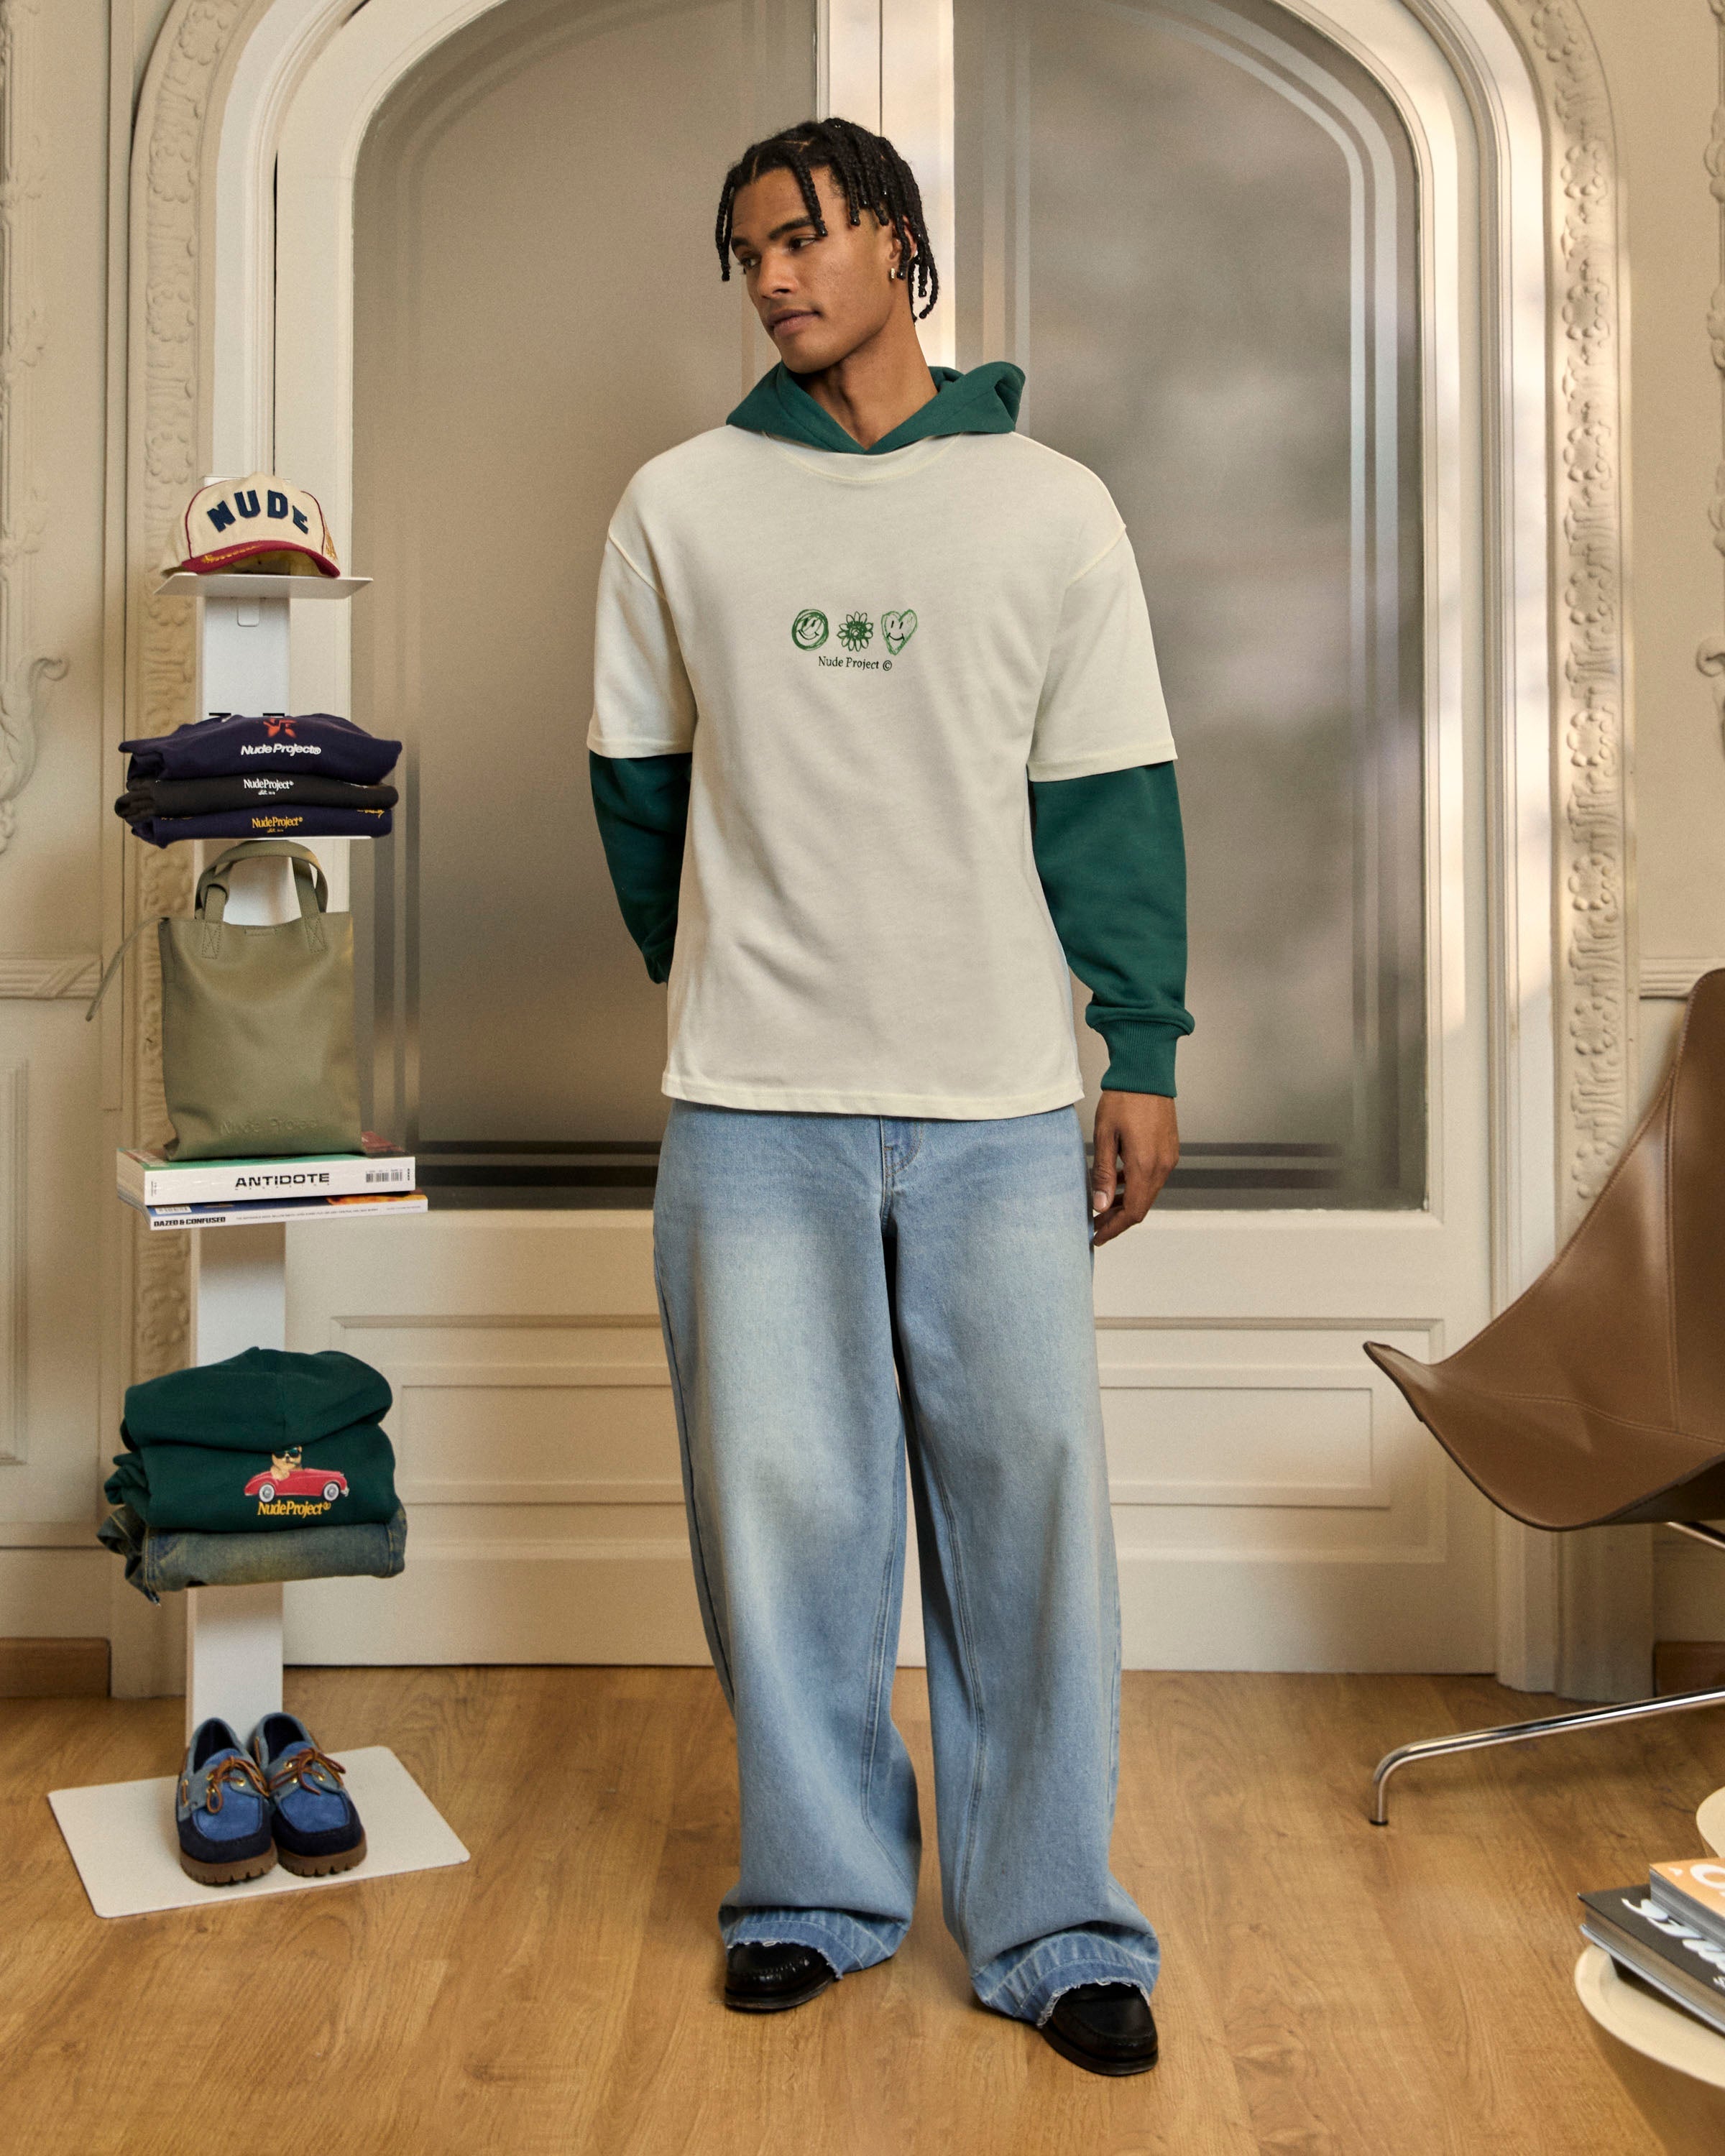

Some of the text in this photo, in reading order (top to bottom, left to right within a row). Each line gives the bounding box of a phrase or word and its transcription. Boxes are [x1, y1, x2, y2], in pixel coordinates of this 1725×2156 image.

[207, 489, 308, 534] NUDE
[818, 655, 844, 667] Nude
[846, 657, 879, 671] Project
[235, 1173, 330, 1187] ANTIDOTE
